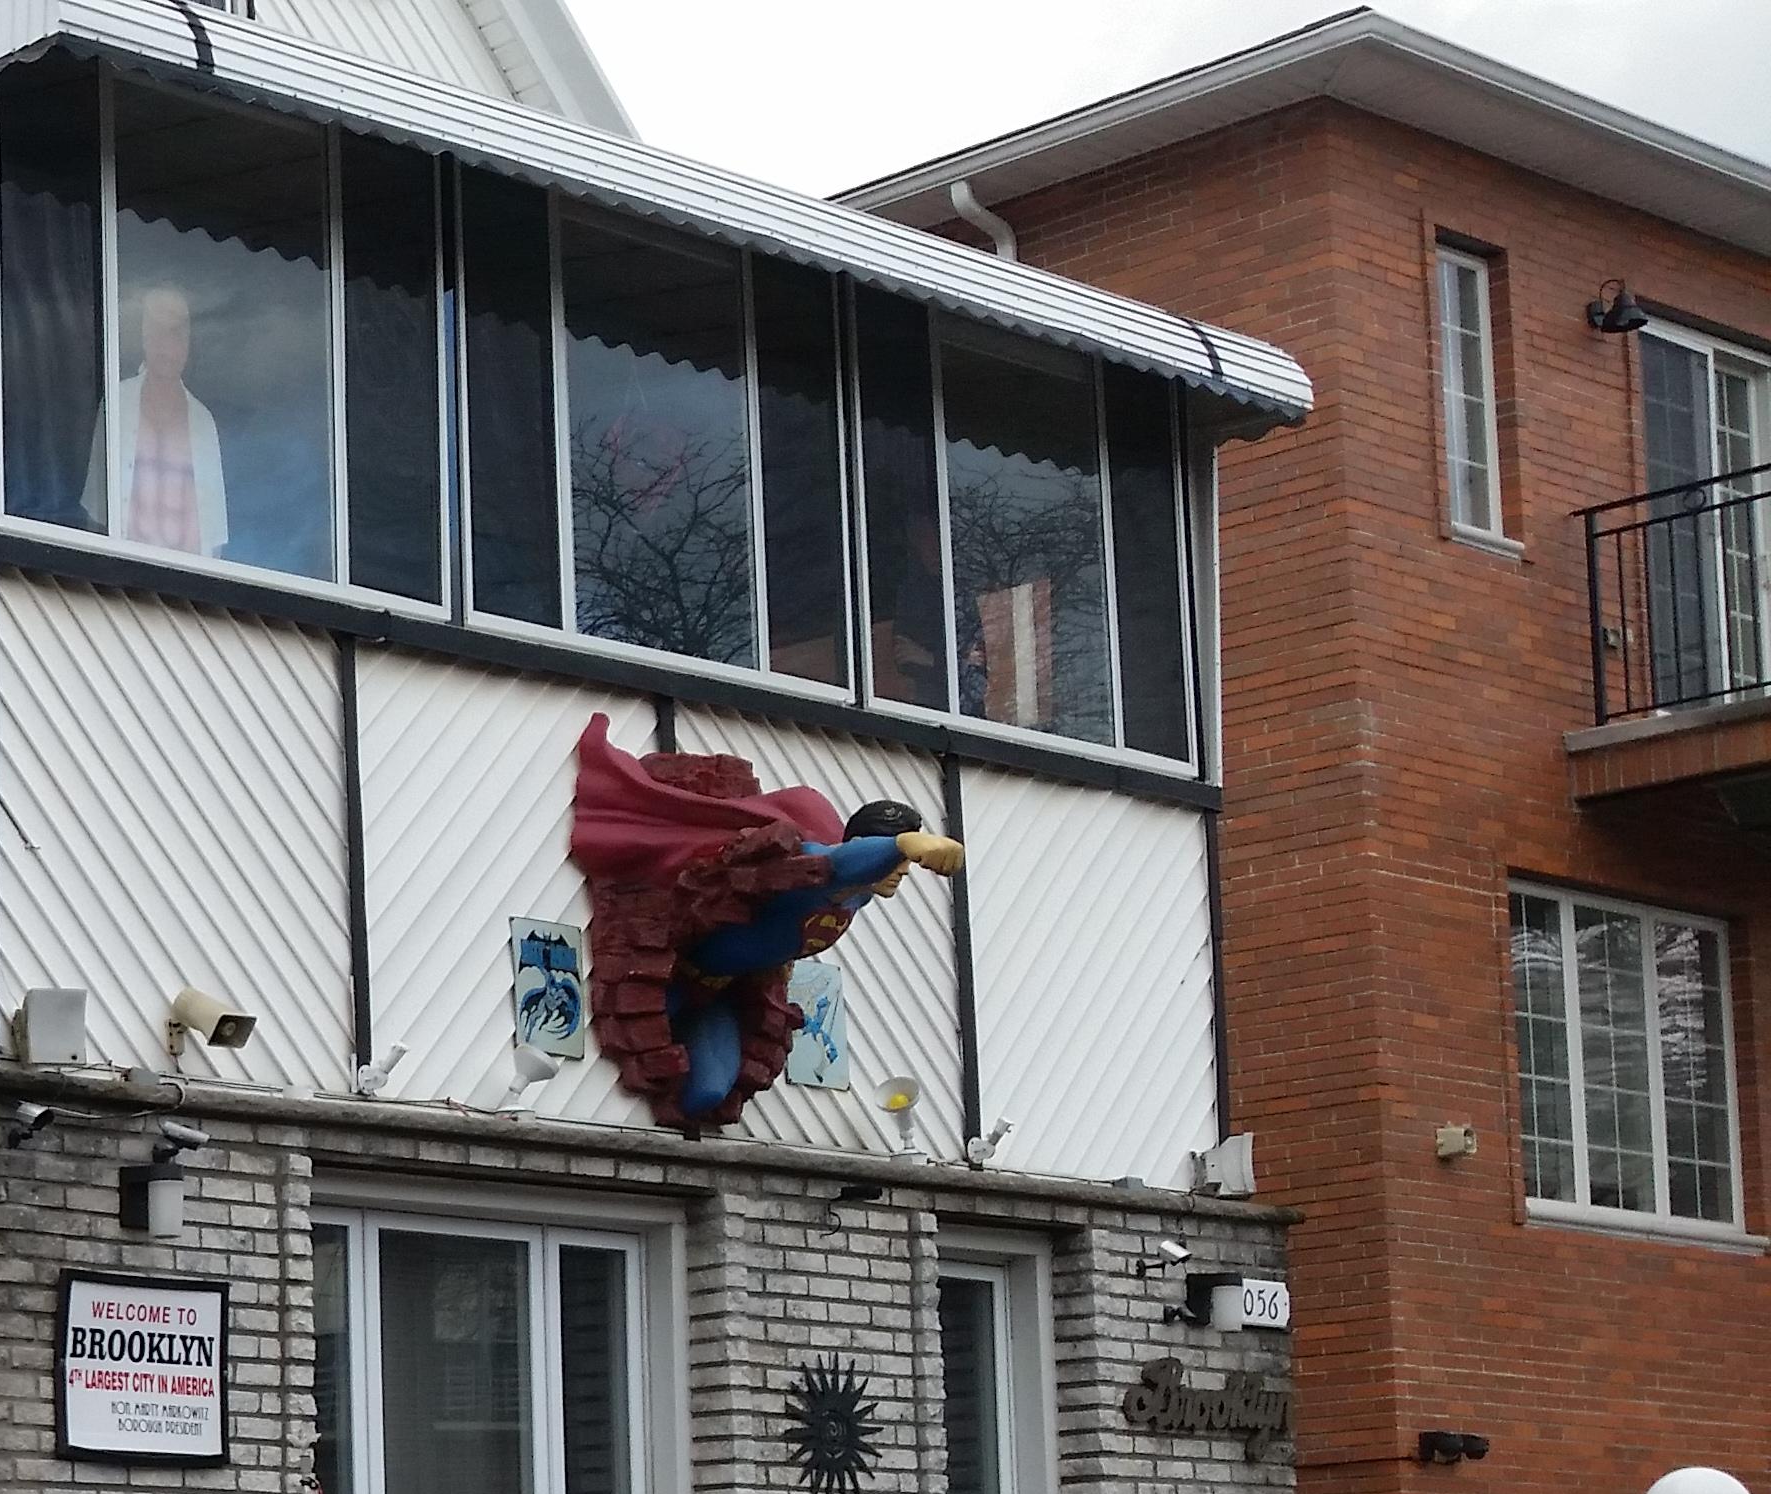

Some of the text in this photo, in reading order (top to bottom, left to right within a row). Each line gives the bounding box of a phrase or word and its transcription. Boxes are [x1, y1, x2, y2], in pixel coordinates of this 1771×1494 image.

[92, 1301, 197, 1325] WELCOME TO
[70, 1326, 214, 1367] BROOKLYN
[85, 1370, 130, 1391] LARGEST
[133, 1373, 154, 1392] CITY
[158, 1375, 167, 1393] IN
[171, 1376, 215, 1397] AMERICA
[134, 1402, 159, 1417] MARTY
[161, 1404, 209, 1421] MARKOWITZ
[1123, 1357, 1288, 1462] Brooklyn
[118, 1418, 203, 1436] BOROUGH PRESIDENT
